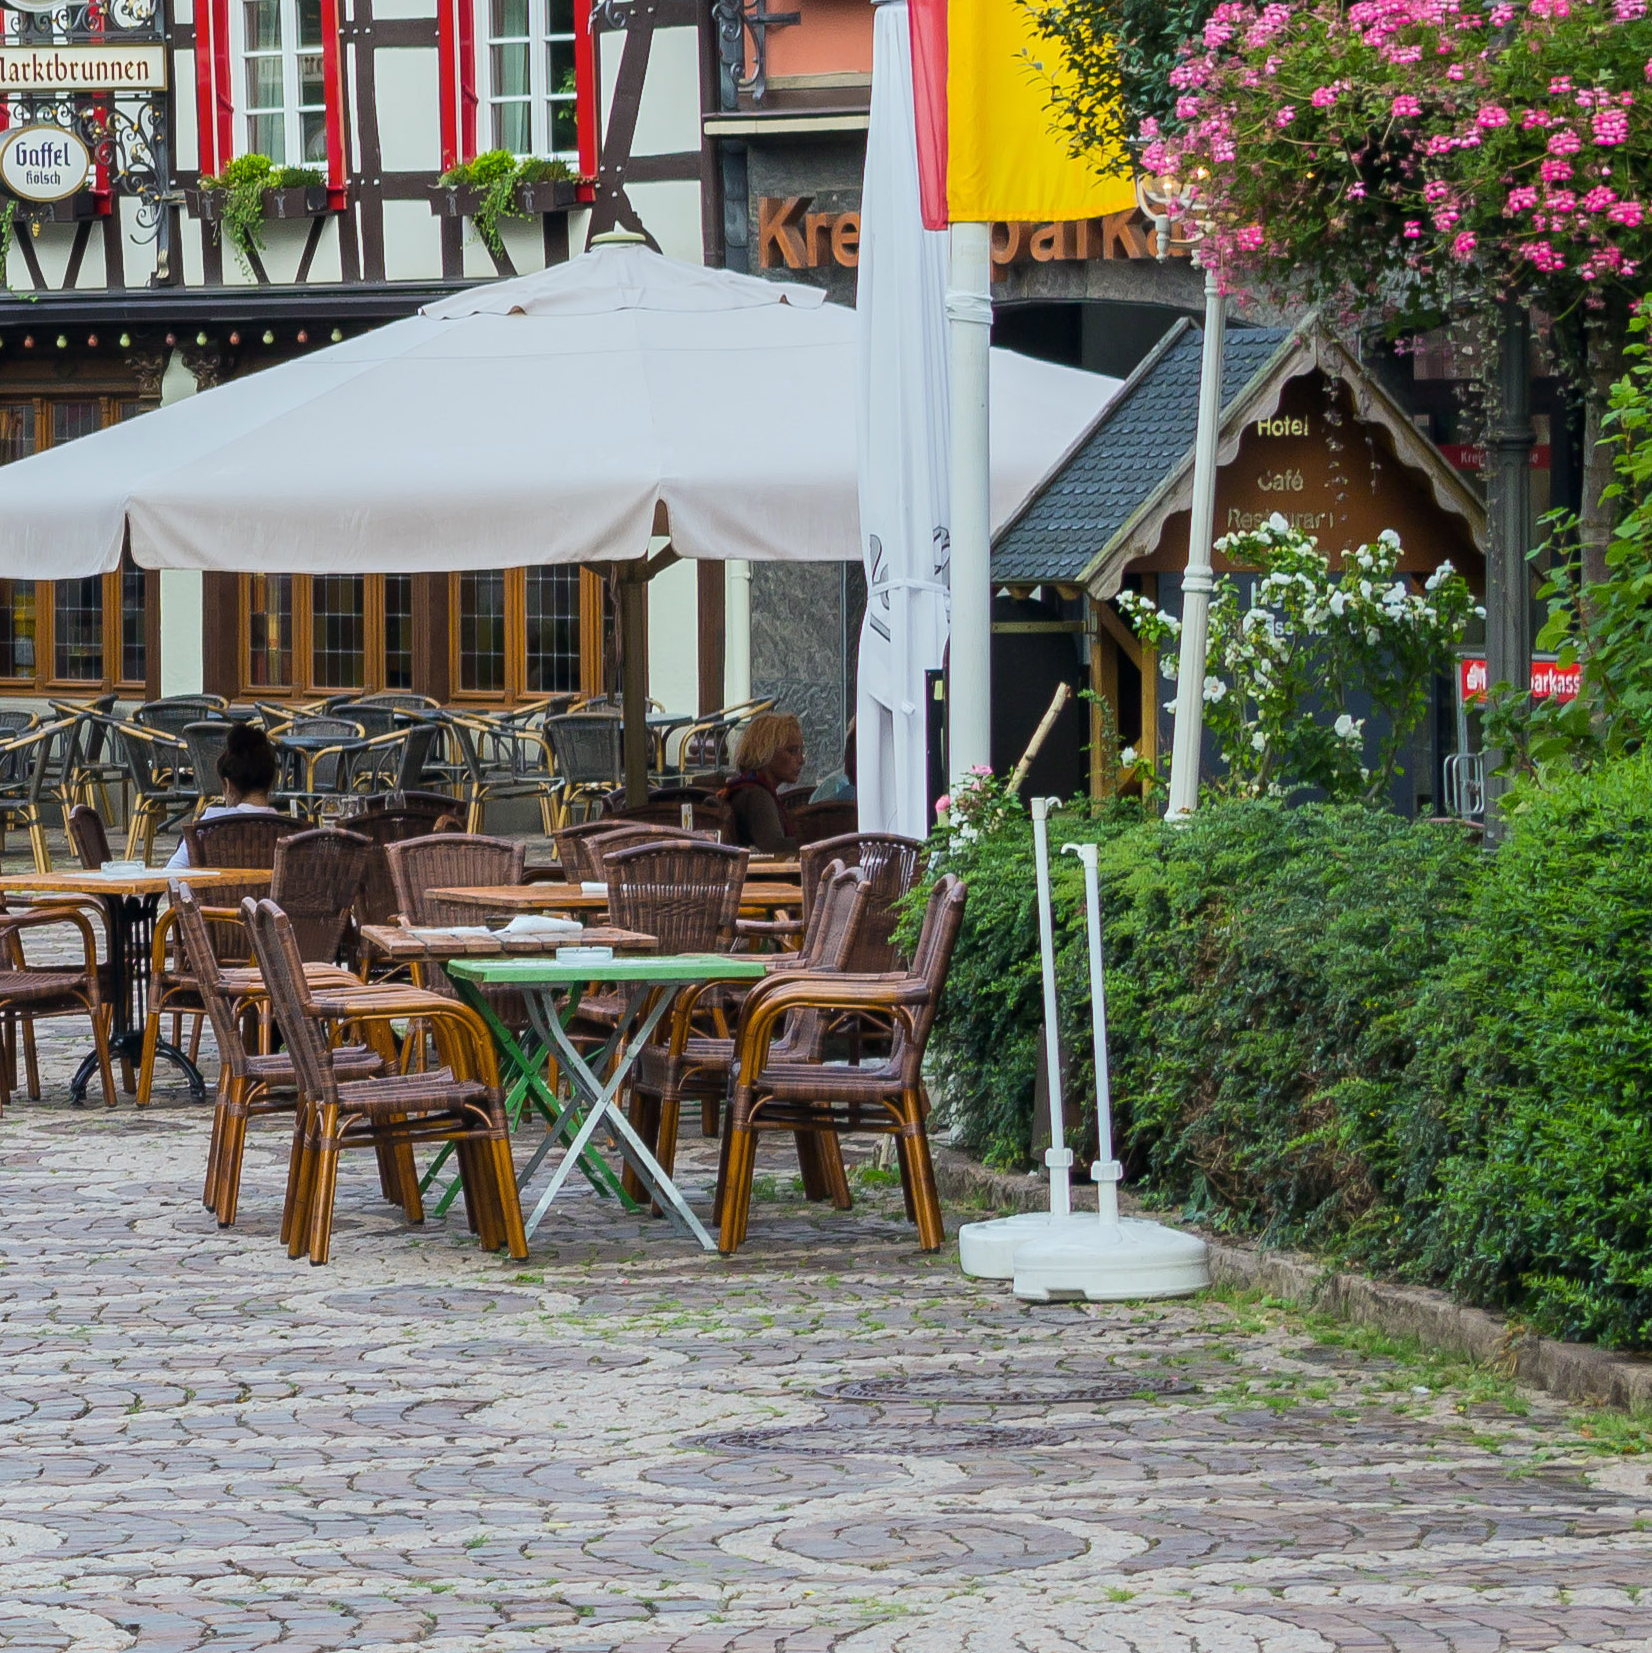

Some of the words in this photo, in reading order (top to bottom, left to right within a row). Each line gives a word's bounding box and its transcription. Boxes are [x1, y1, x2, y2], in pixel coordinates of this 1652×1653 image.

[16, 141, 71, 169] Gaffel
[25, 170, 61, 186] Kölsch
[1257, 414, 1309, 436] Hotel
